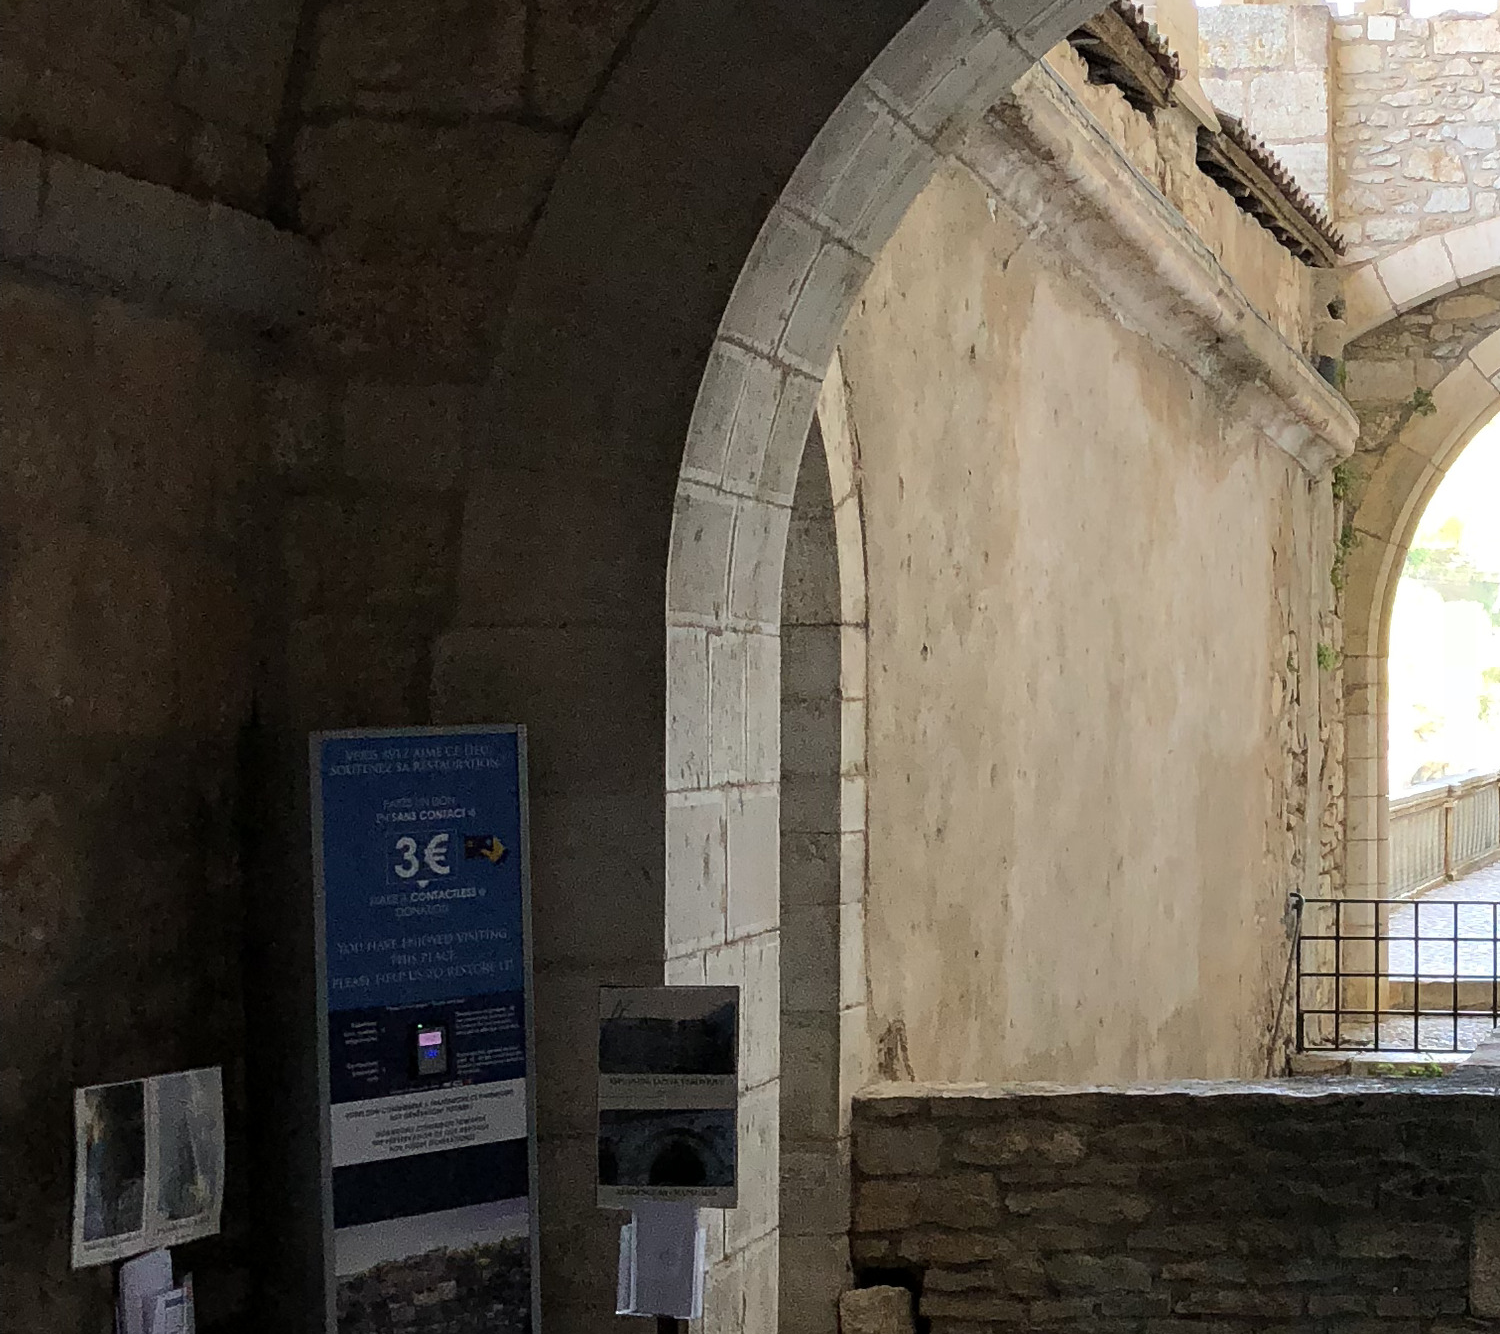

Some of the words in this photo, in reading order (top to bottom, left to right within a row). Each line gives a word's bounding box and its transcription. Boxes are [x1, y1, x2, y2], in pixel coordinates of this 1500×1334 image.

[419, 808, 466, 820] CONTACT
[394, 833, 451, 878] 3€
[410, 887, 477, 902] CONTACTLESS
